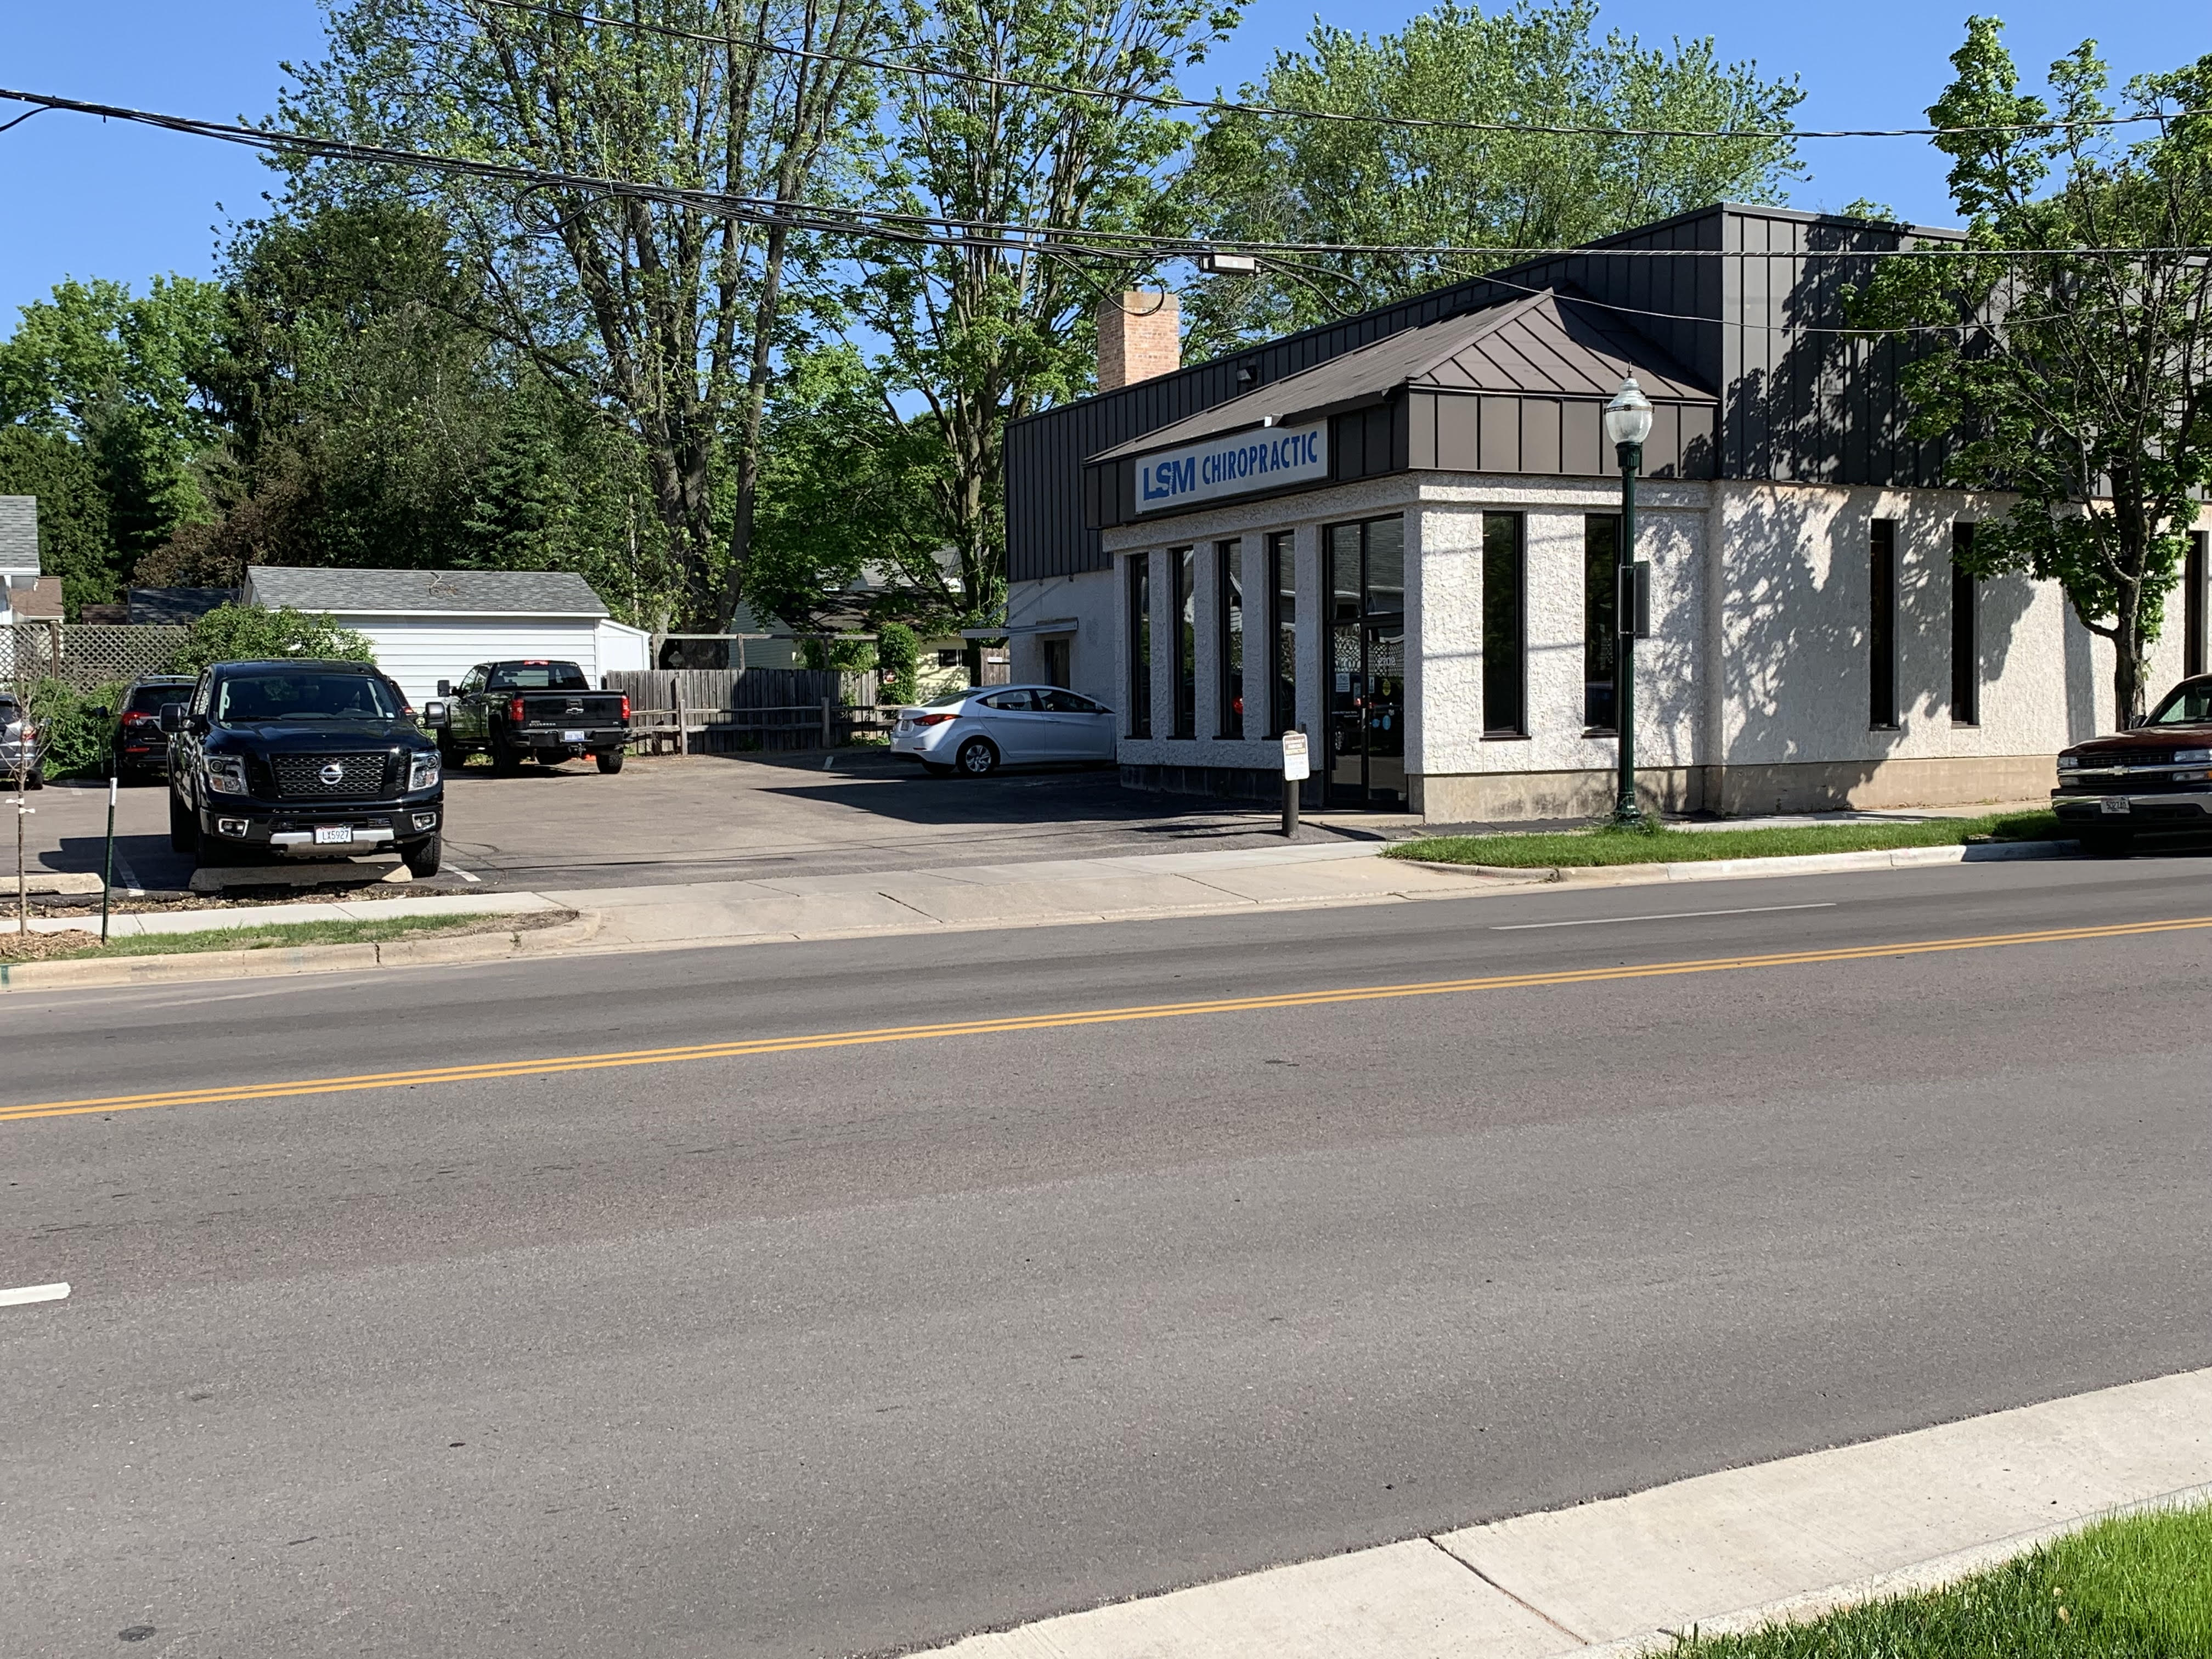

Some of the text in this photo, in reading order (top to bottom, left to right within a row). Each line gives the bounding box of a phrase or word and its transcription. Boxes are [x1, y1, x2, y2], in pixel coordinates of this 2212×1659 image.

[1143, 431, 1317, 501] LSM CHIROPRACTIC
[323, 830, 349, 840] LX5927
